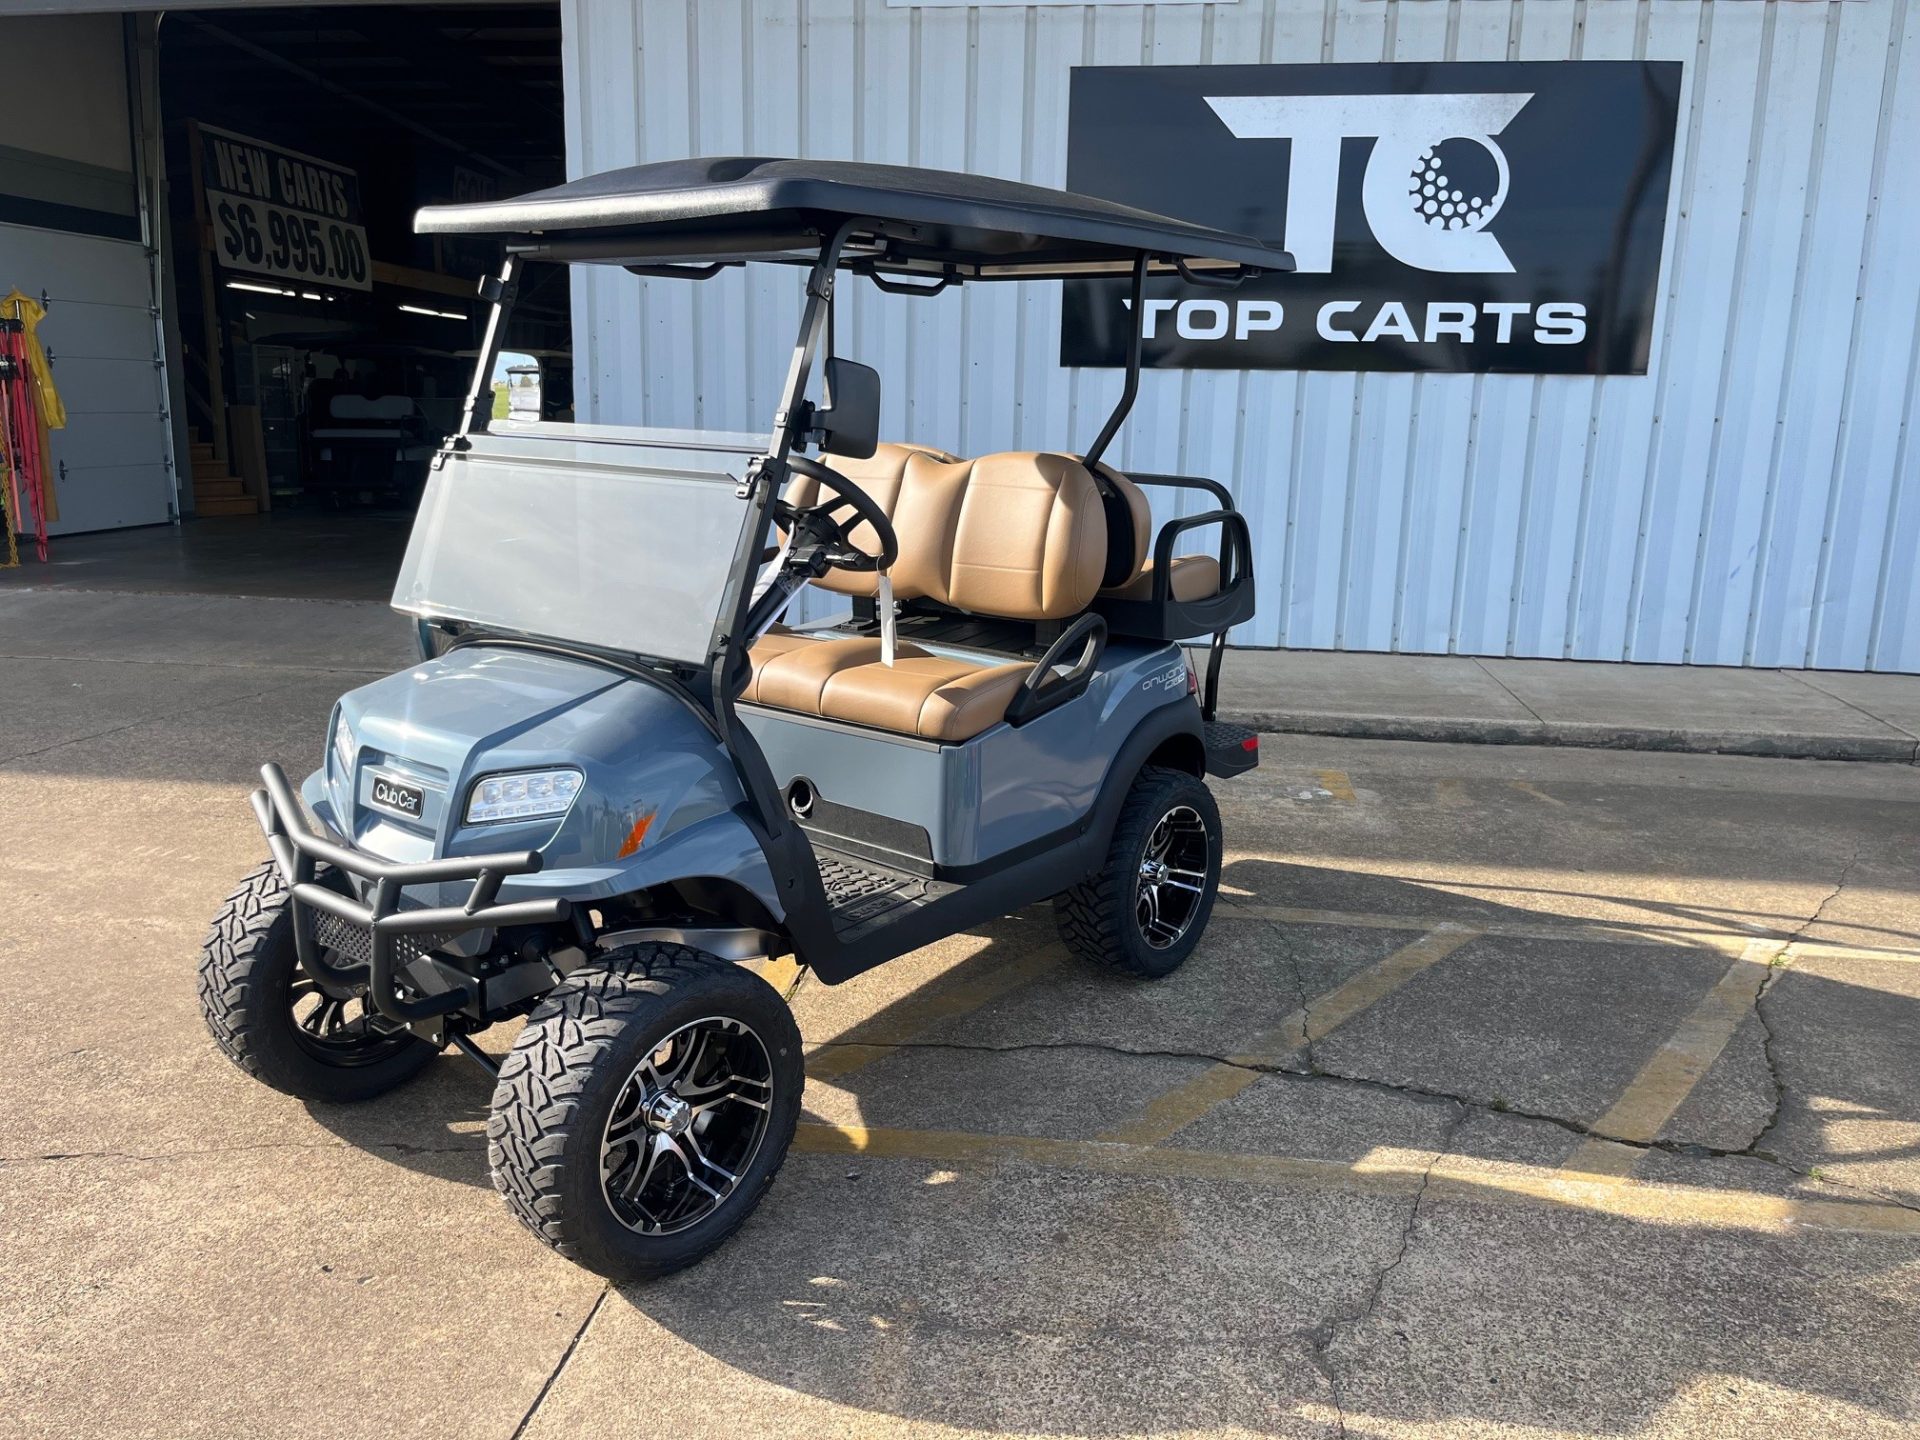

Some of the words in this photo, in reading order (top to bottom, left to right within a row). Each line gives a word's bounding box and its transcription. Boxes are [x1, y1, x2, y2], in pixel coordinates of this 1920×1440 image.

[214, 140, 271, 199] NEW
[278, 158, 348, 218] CARTS
[218, 199, 366, 283] $6,995.00
[1122, 299, 1284, 340] TOP
[1316, 301, 1587, 344] CARTS
[376, 783, 398, 804] Club
[398, 790, 418, 810] Car
